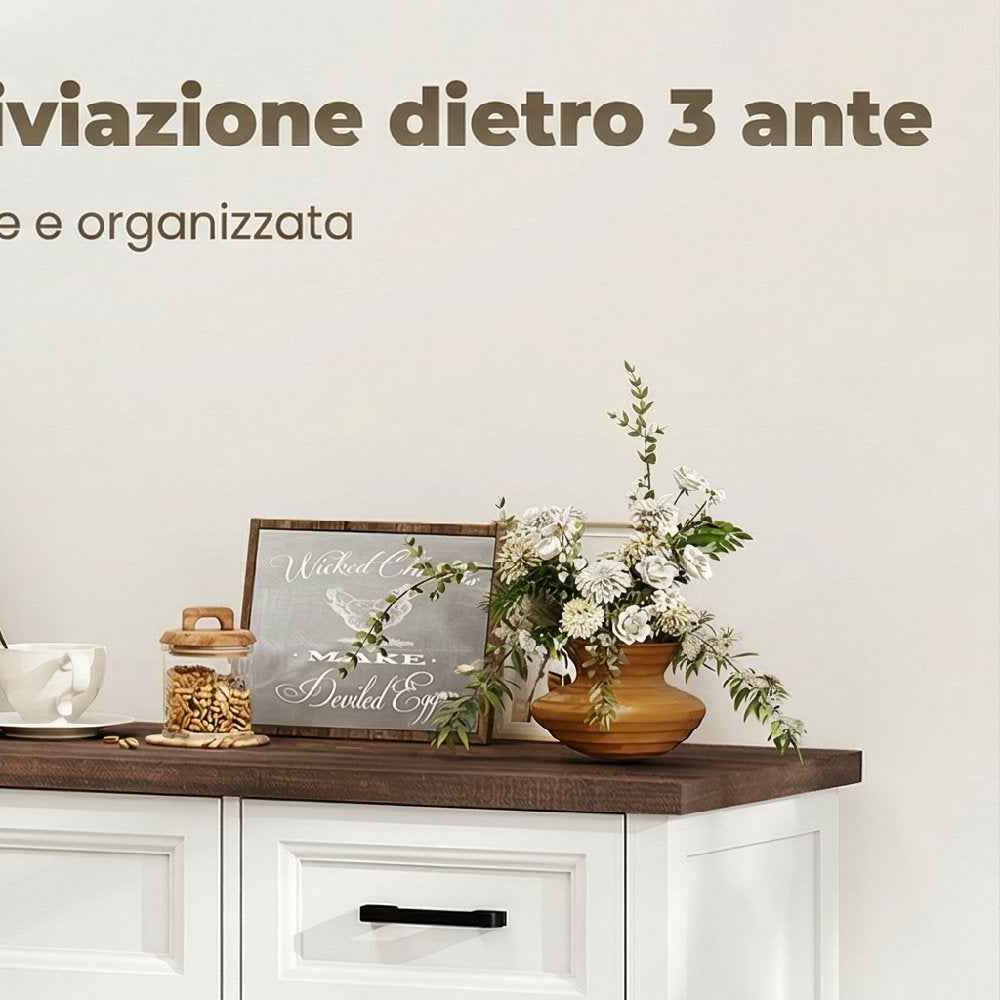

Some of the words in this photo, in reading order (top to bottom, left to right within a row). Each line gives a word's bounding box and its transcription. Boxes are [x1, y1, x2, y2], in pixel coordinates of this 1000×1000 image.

[272, 550, 386, 583] Wicked
[308, 649, 426, 666] MAKE
[275, 668, 398, 710] Deviled
[391, 671, 440, 727] Egg
